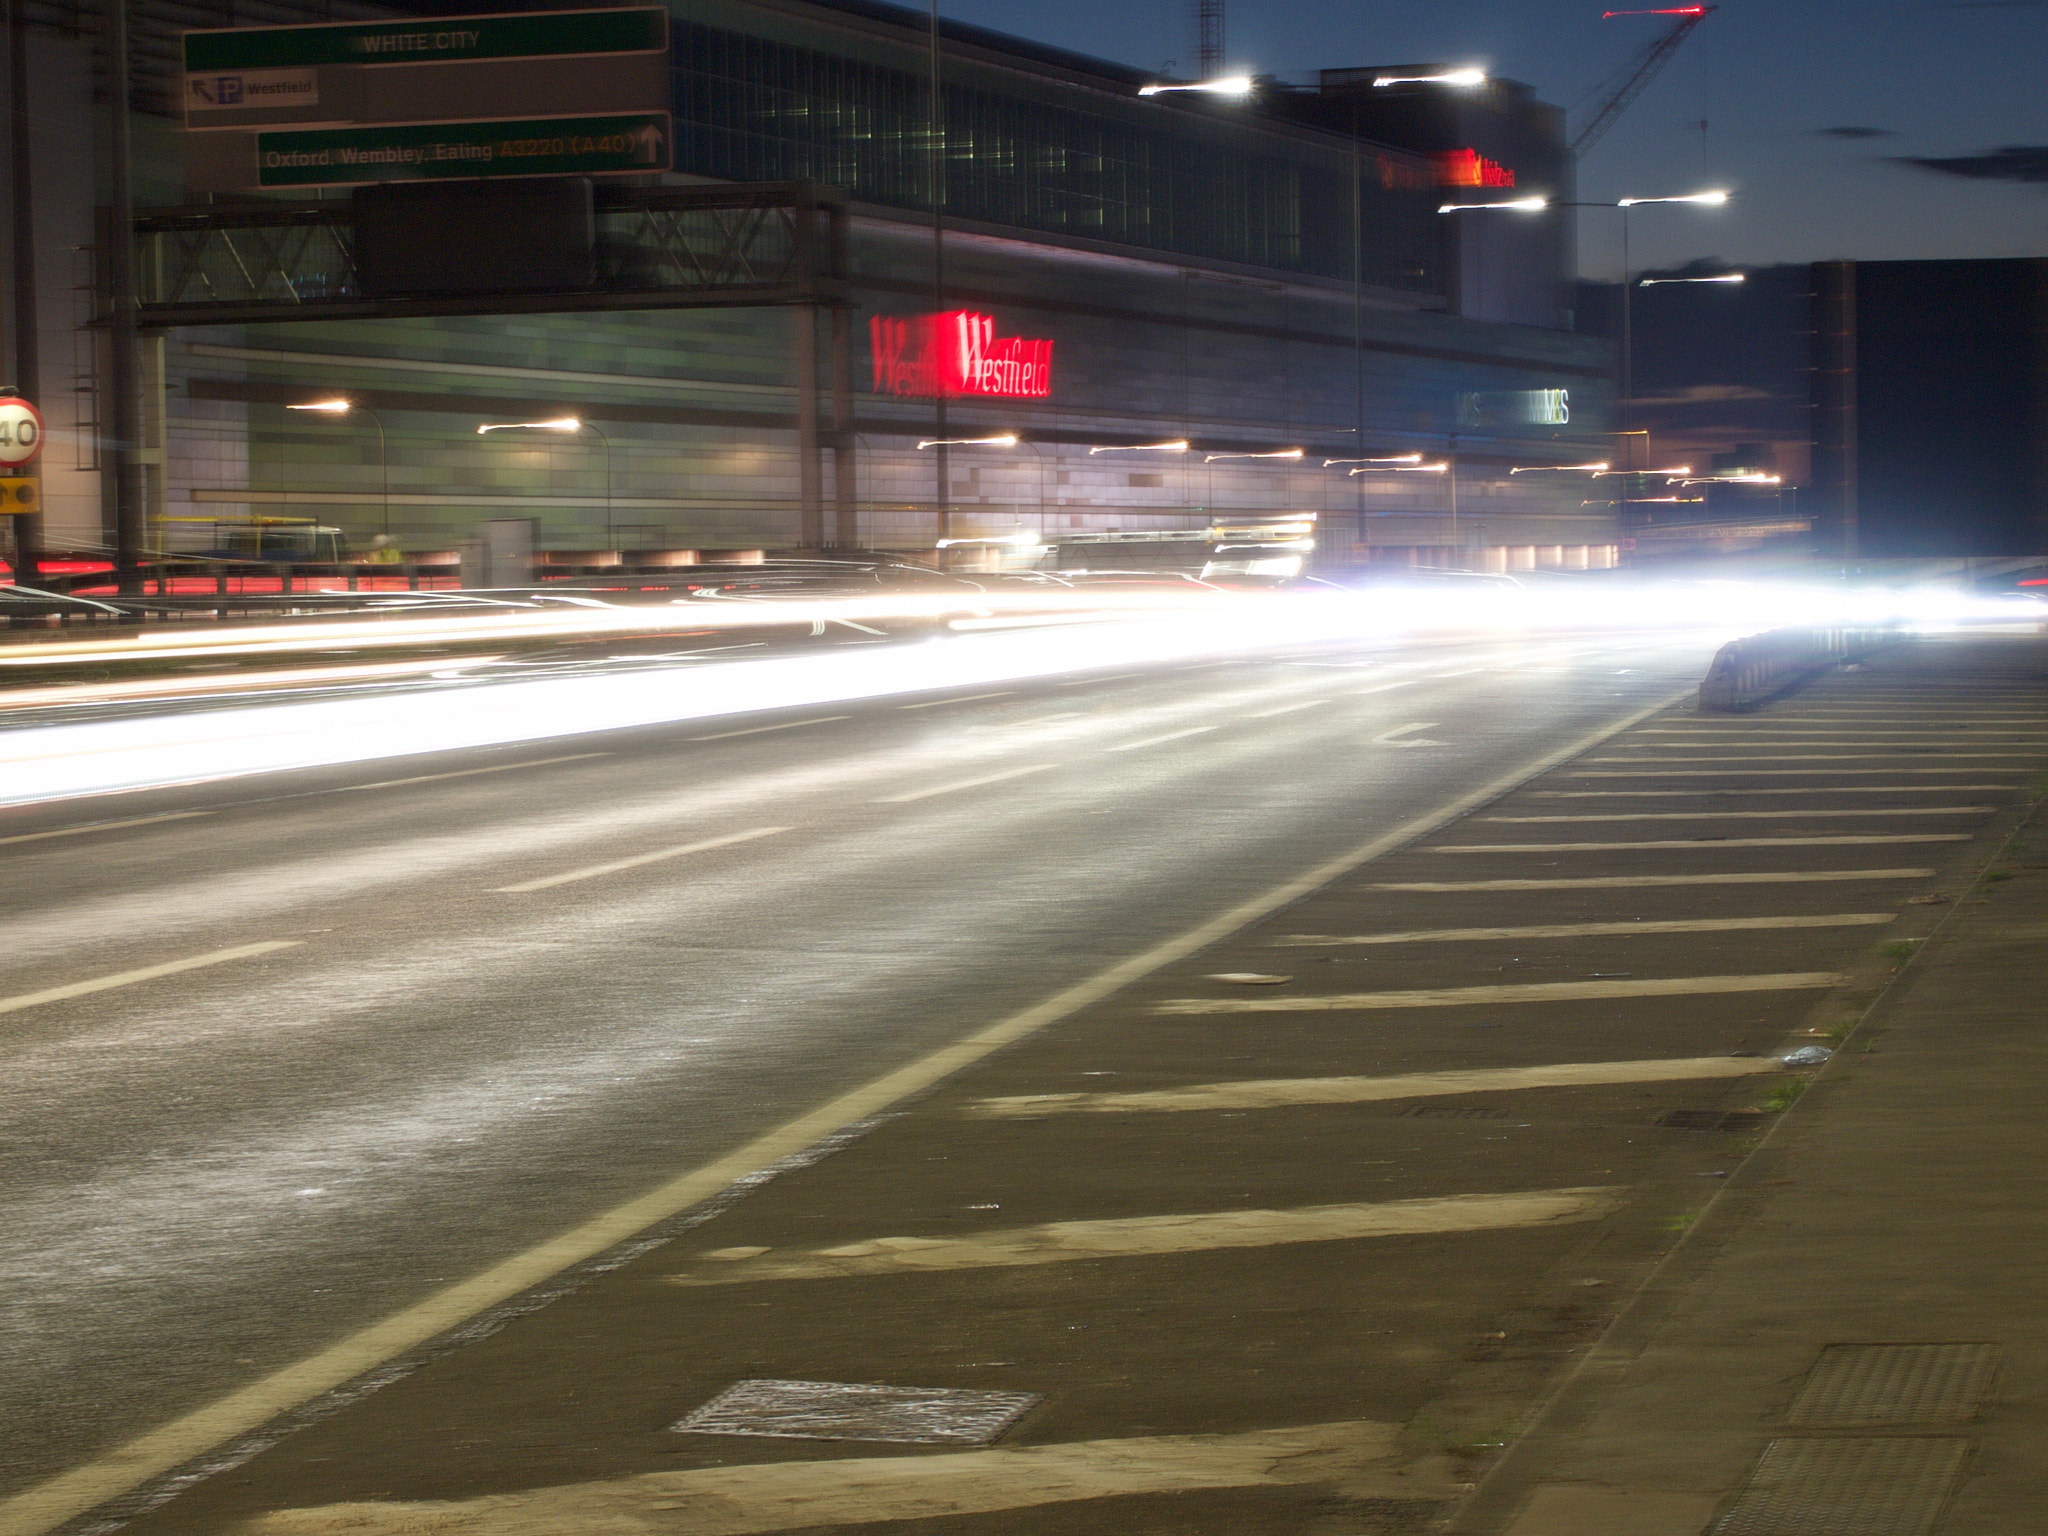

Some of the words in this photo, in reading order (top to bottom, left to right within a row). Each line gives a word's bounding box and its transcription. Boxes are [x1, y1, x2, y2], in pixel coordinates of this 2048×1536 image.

[363, 33, 428, 53] WHITE
[435, 30, 480, 49] CITY
[247, 80, 312, 95] Westfield
[265, 149, 336, 168] Oxford,
[435, 142, 493, 161] Ealing
[499, 138, 565, 158] A3220
[570, 132, 637, 156] (A40)
[956, 308, 1054, 397] Westfield
[1543, 387, 1570, 425] M&S
[0, 418, 37, 447] 40
